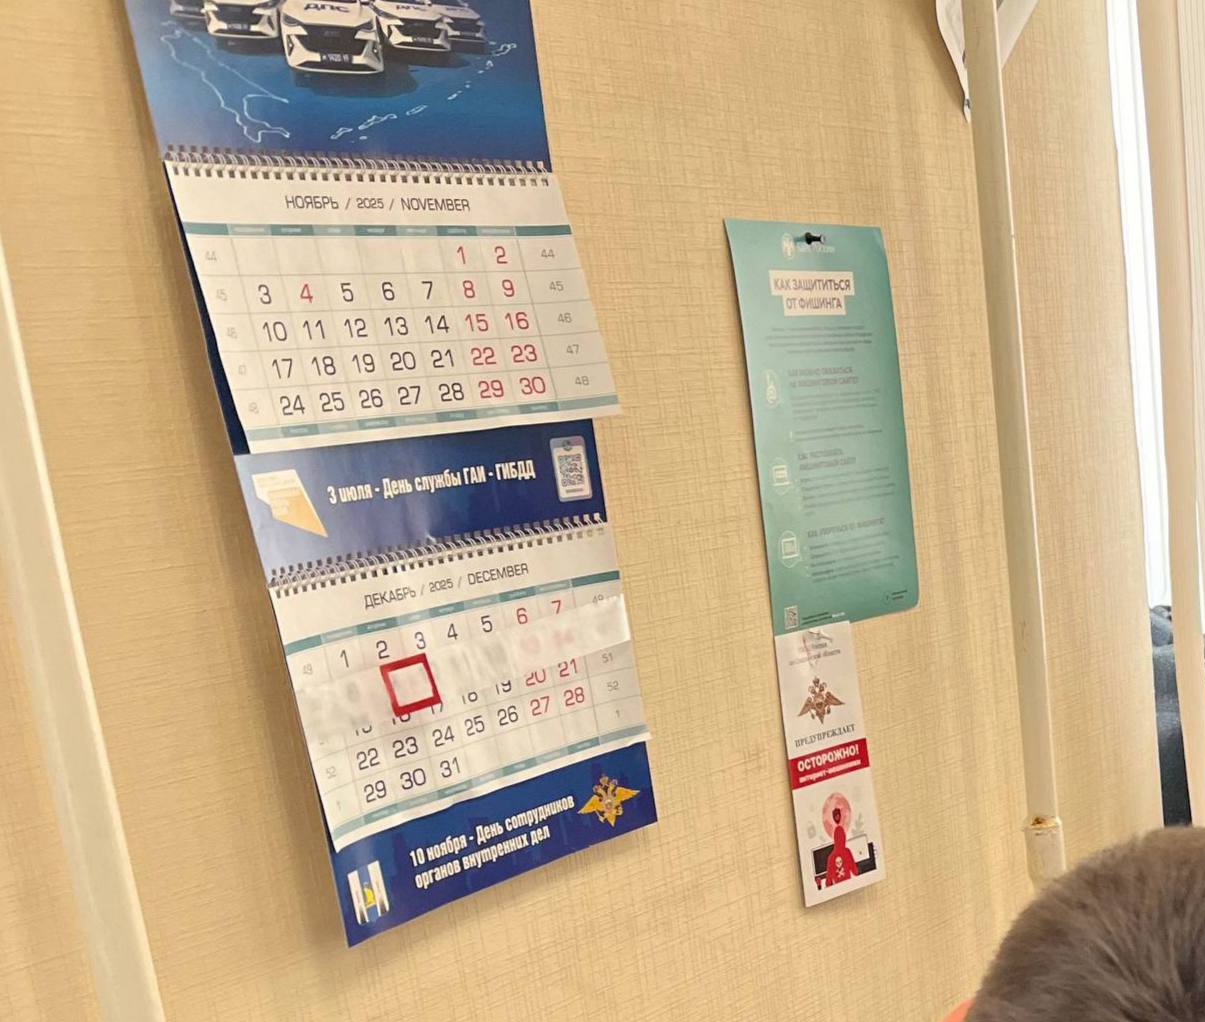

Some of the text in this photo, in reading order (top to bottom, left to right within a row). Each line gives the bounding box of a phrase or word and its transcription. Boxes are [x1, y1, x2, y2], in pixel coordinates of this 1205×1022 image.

[285, 195, 339, 209] НОЯБРЬ
[356, 198, 384, 209] 2025
[401, 198, 471, 211] NOVEMBER
[457, 246, 466, 264] 1
[494, 246, 508, 264] 2
[541, 249, 555, 258] 44
[258, 284, 272, 304] 3
[300, 283, 313, 303] 4
[341, 282, 354, 302] 5
[382, 282, 395, 301] 6
[421, 281, 433, 299] 7
[463, 280, 475, 298] 8
[502, 279, 515, 297] 9
[549, 281, 564, 291] 45
[773, 278, 851, 292] КАК ЗАЩИТИТЬСЯ
[786, 297, 843, 309] ОТ ФИШИНГА
[262, 321, 287, 342] 10
[303, 320, 325, 340] 11
[344, 318, 368, 338] 12
[384, 317, 409, 336] 13
[425, 315, 450, 334] 14
[465, 313, 489, 332] 15
[505, 312, 529, 330] 16
[558, 313, 572, 324] 46
[272, 344, 580, 379] 17 18 19 20 21 22 23 47
[280, 376, 590, 416] 24 25 26 27 28 29 30 48
[327, 486, 337, 504] 3
[338, 483, 372, 503] июля
[382, 477, 413, 500] День
[414, 469, 462, 493] службы
[463, 465, 487, 485] ГАИ
[495, 459, 536, 481] ГИБДД
[364, 587, 417, 610] ДЕКАБРЬ
[429, 579, 453, 593] 2025
[467, 563, 529, 585] DECEMBER
[340, 649, 349, 668] 1
[376, 640, 390, 659] 2
[414, 631, 426, 650] 3
[447, 623, 458, 640] 4
[481, 615, 493, 633] 5
[516, 607, 528, 625] 6
[551, 600, 562, 614] 7
[558, 659, 578, 678] 21
[357, 748, 381, 770] 22
[392, 736, 419, 759] 23
[432, 726, 455, 747] 24
[464, 715, 485, 736] 25
[497, 705, 519, 726] 26
[530, 696, 550, 717] 27
[564, 687, 585, 707] 28
[794, 723, 856, 748] ПРЕДУПРЕЖДАЕТ
[797, 744, 860, 773] ОСТОРОЖНО!
[364, 780, 387, 803] 29
[400, 768, 426, 790] 30
[440, 757, 461, 778] 31
[409, 848, 425, 867] 10
[426, 836, 468, 862] ноября
[475, 822, 504, 845] День
[505, 795, 575, 832] сотрудников
[414, 825, 550, 889] органов внутренних дел
